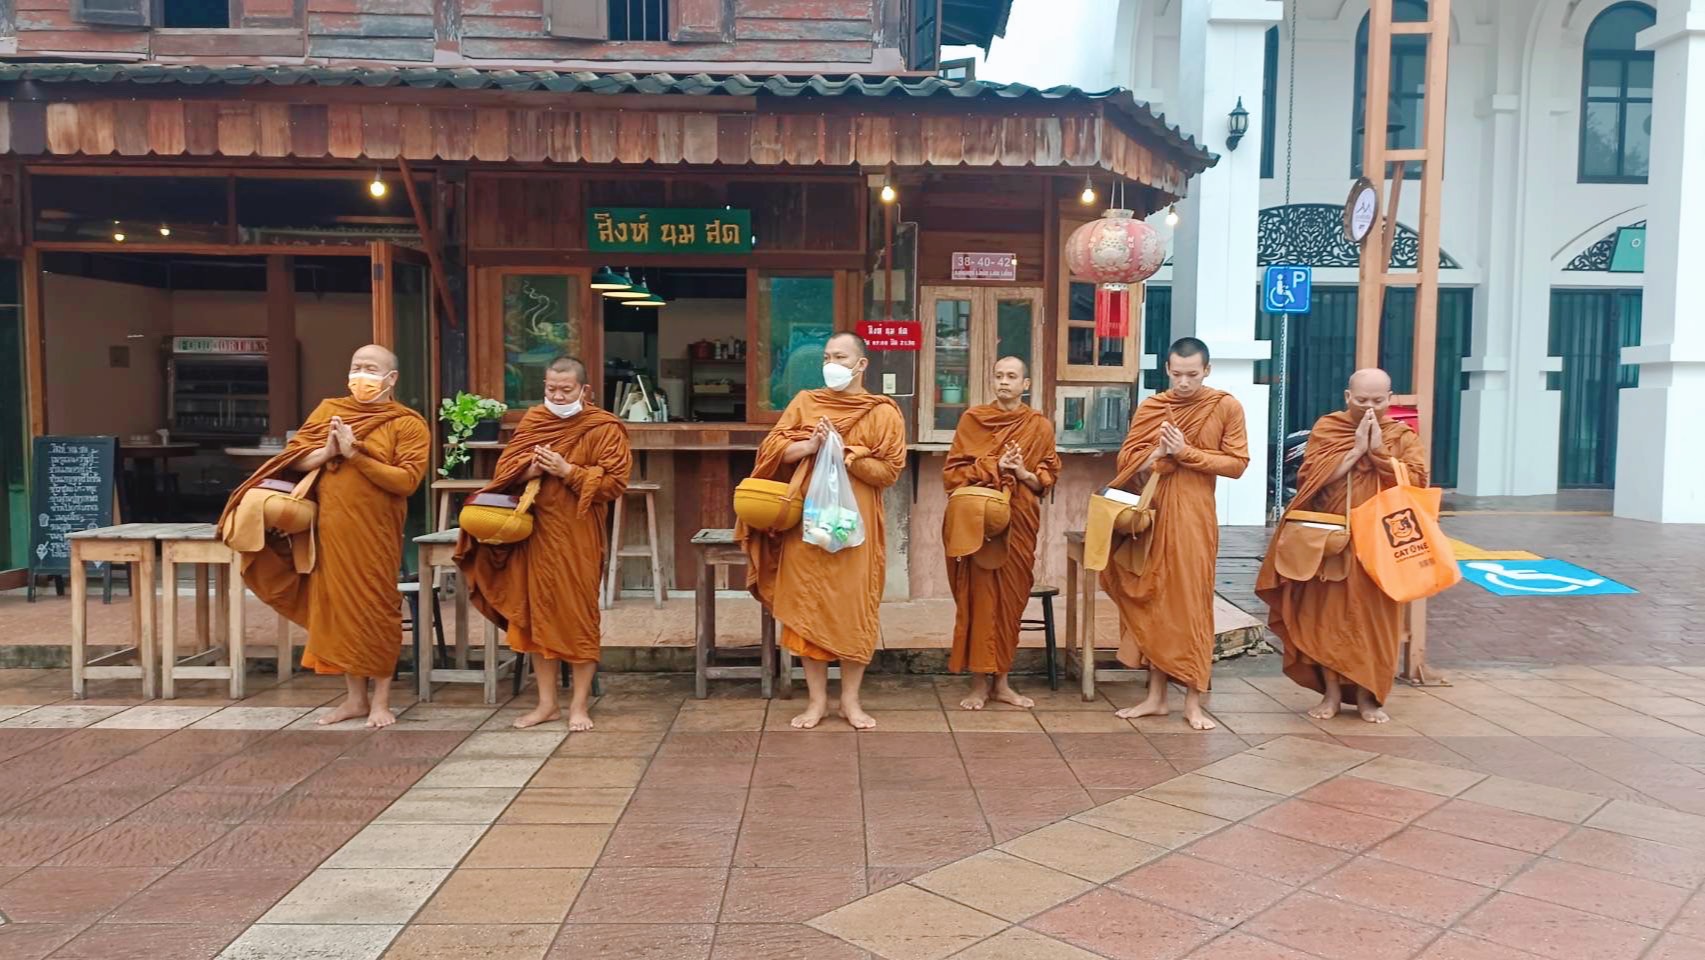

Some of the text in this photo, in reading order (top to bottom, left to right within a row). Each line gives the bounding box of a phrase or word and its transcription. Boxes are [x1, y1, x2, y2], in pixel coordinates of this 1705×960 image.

[594, 213, 740, 246] สิงห์ นม สด
[1293, 271, 1306, 288] P
[1394, 548, 1409, 558] CAT
